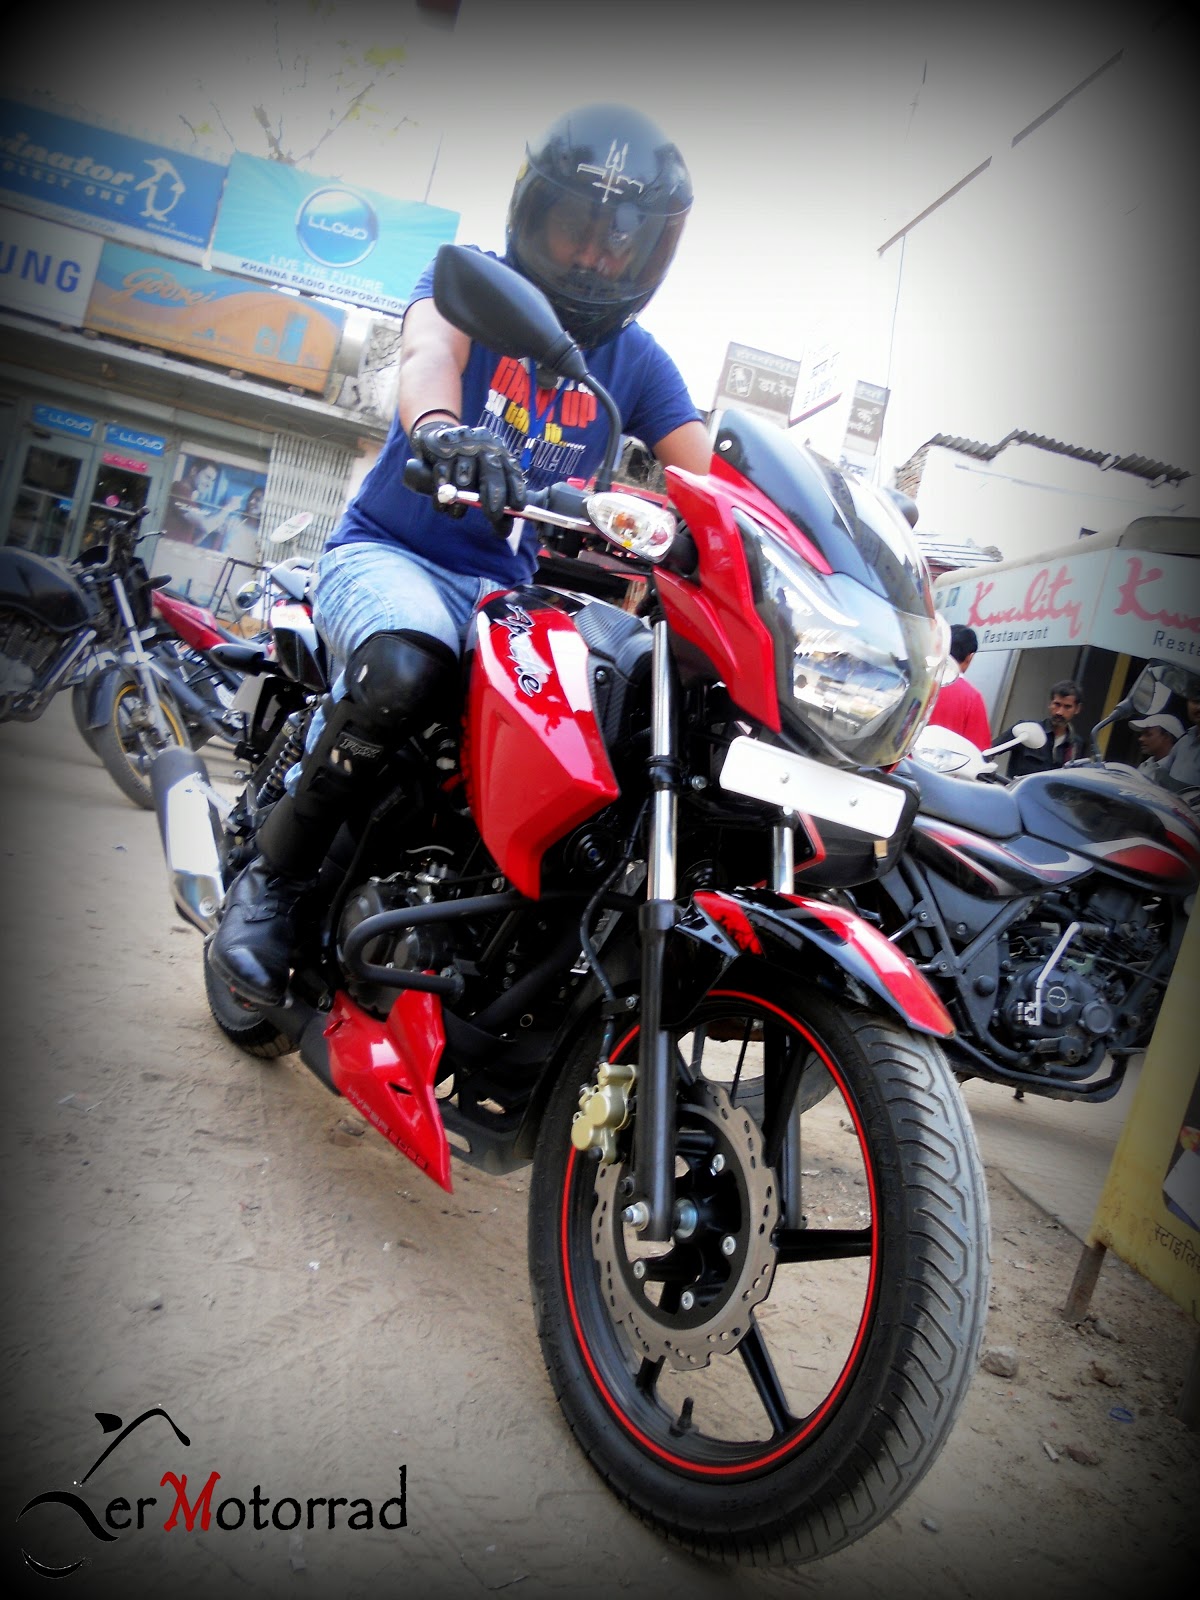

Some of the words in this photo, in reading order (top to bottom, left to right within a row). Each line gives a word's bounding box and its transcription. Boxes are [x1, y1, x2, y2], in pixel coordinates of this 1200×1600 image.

[85, 185, 126, 206] ONE
[307, 215, 368, 241] LLOYD
[240, 261, 289, 282] KHANNA
[291, 274, 326, 293] RADIO
[328, 285, 408, 311] CORPORATION
[269, 254, 298, 271] LIVE
[302, 261, 328, 279] THE
[331, 267, 384, 292] FUTURE
[982, 626, 1048, 644] Restaurant
